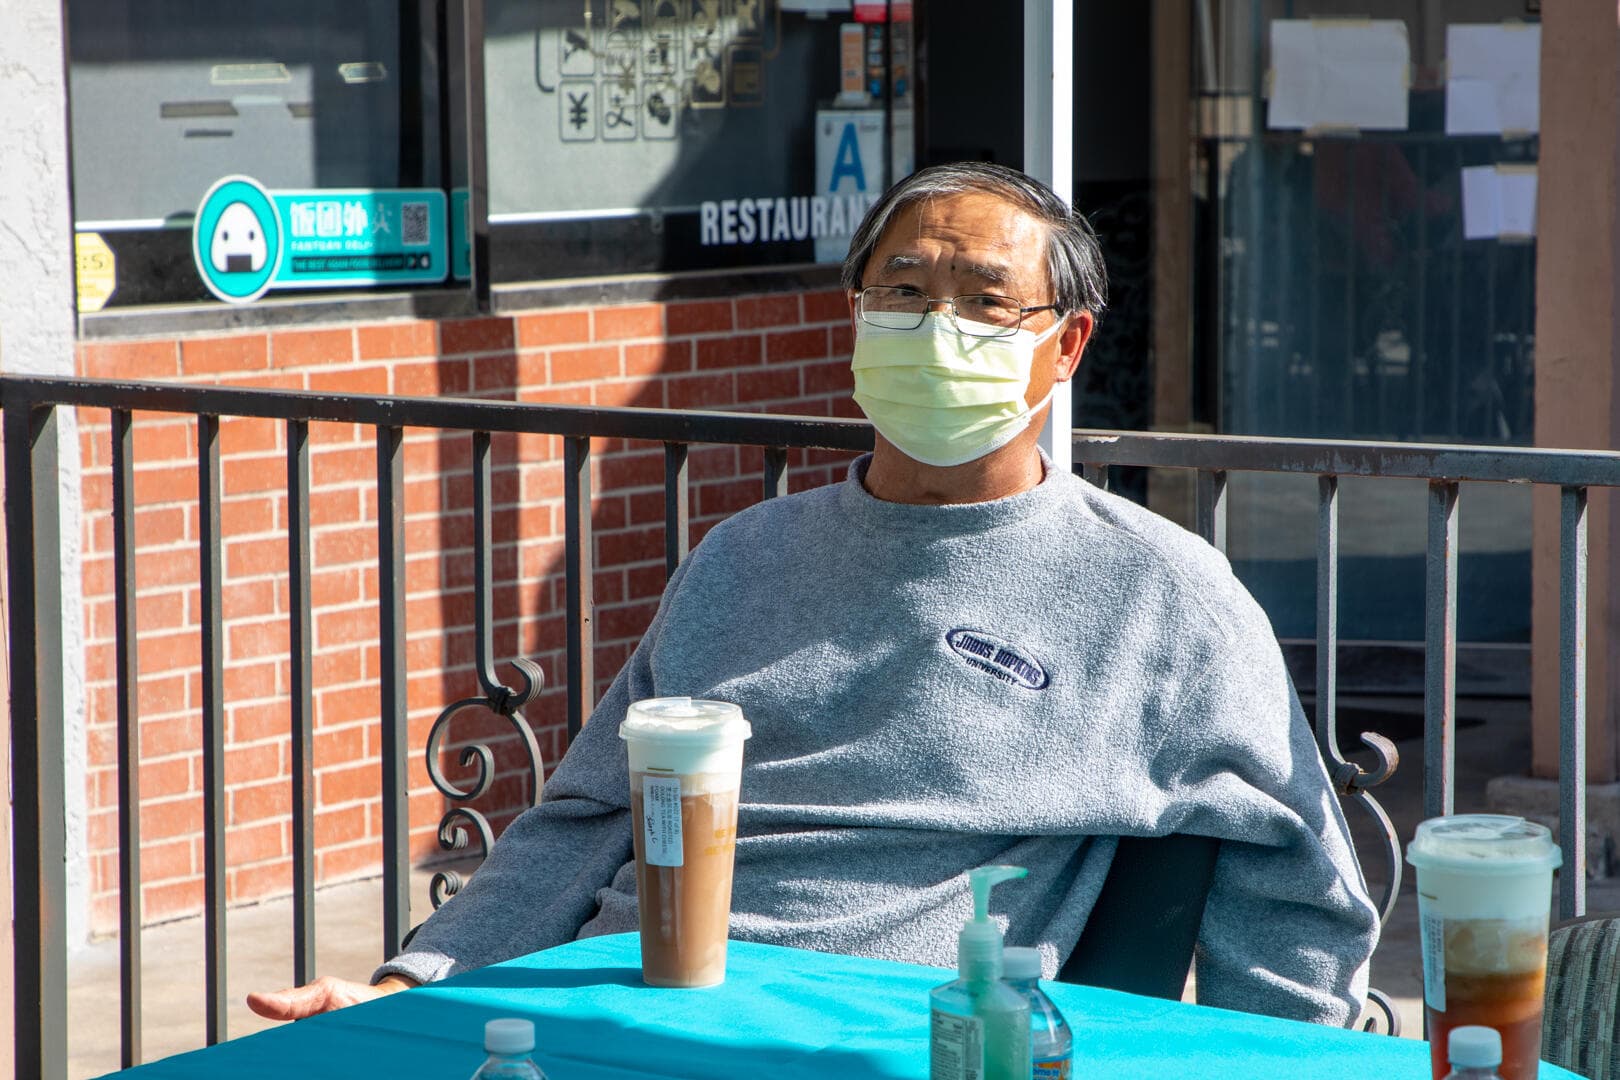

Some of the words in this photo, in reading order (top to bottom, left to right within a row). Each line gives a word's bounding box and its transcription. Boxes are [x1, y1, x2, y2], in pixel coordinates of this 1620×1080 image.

[829, 122, 866, 192] A
[956, 634, 995, 659] JOHNS
[993, 648, 1041, 685] HOPKINS
[966, 657, 1018, 685] UNIVERSITY
